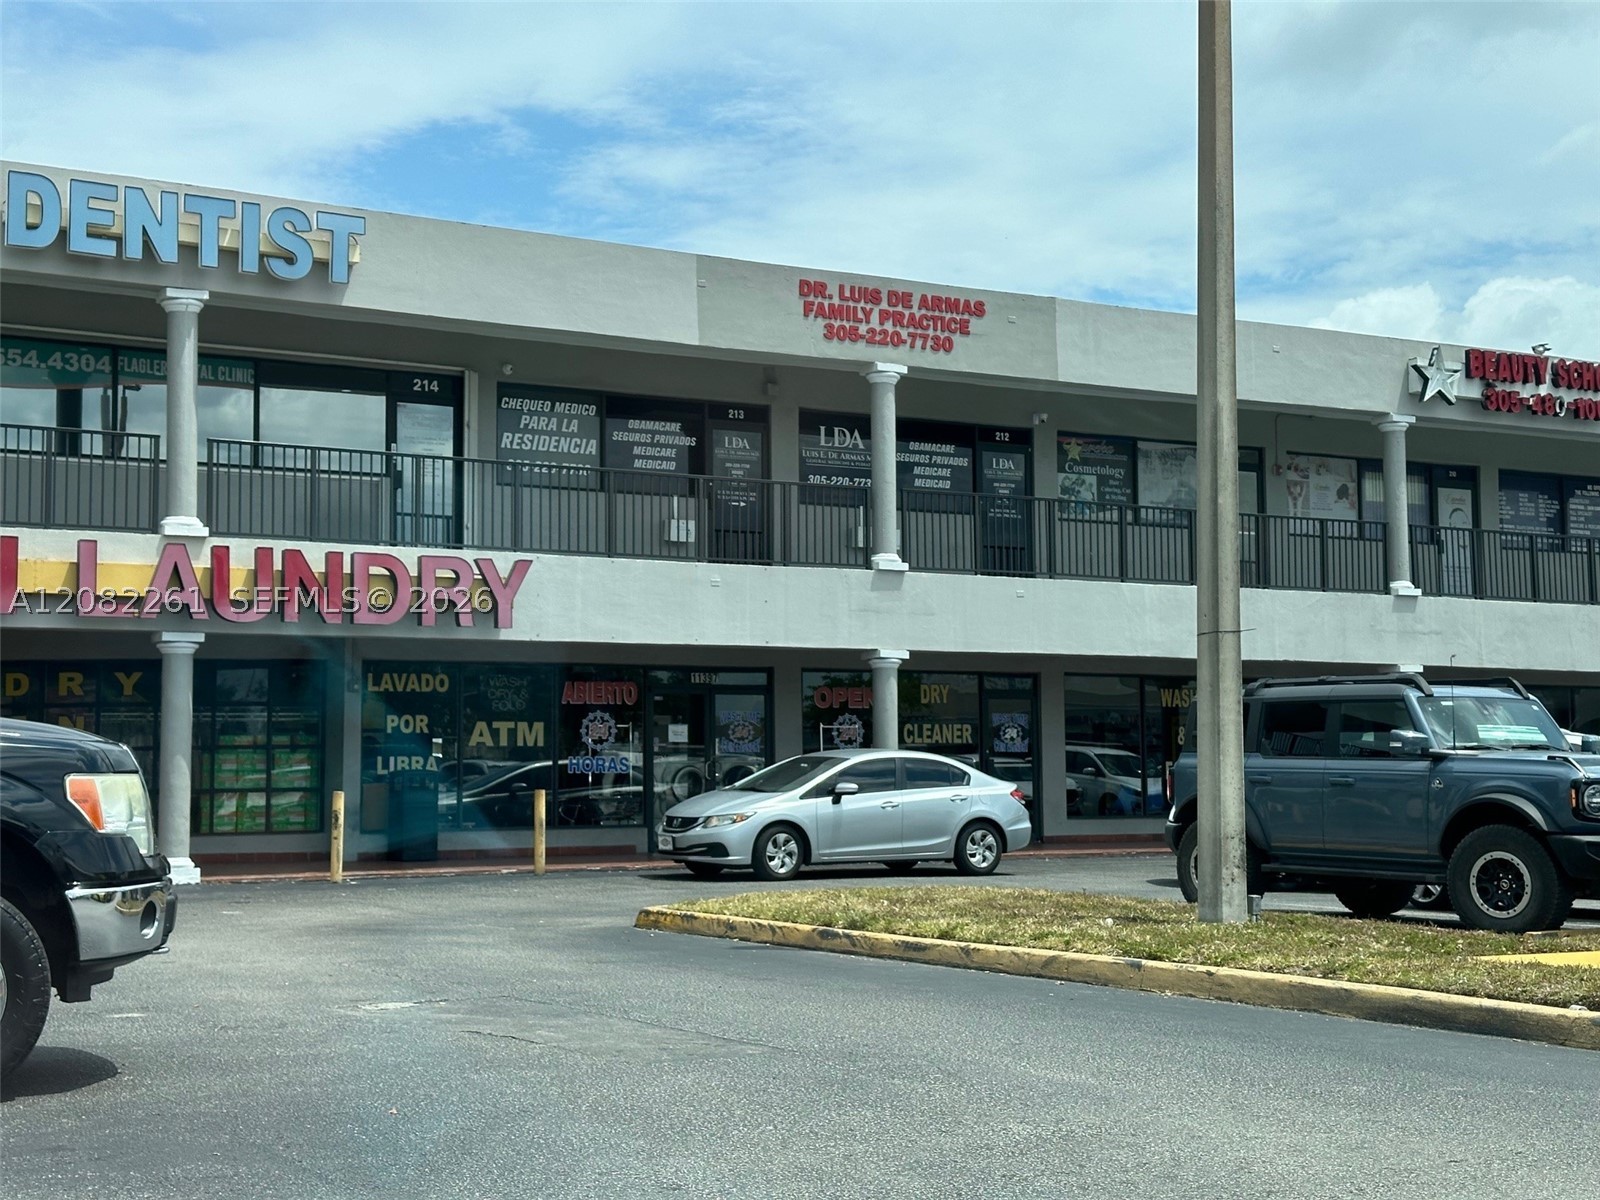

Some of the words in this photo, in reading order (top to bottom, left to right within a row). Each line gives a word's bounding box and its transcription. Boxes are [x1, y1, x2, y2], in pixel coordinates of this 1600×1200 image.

[4, 170, 366, 284] DENTIST
[799, 279, 833, 299] DR.
[839, 284, 882, 305] LUIS
[887, 290, 914, 308] DE
[918, 294, 986, 317] ARMAS
[803, 300, 874, 323] FAMILY
[878, 309, 971, 335] PRACTICE
[823, 323, 954, 352] 305-220-7730
[118, 355, 168, 376] FLAGLER
[218, 366, 255, 384] CLINIC
[1465, 348, 1548, 386] BEAUTY
[413, 379, 439, 392] 214
[501, 397, 551, 413] CHEQUEO
[554, 402, 597, 416] MEDICO
[728, 409, 745, 419] 213
[520, 415, 557, 431] PARA
[562, 418, 578, 433] LA
[628, 419, 682, 432] OBAMACARE
[501, 433, 597, 456] RESIDENCIA
[612, 431, 652, 443] SEGUROS
[654, 434, 697, 447] PRIVADOS
[725, 436, 750, 449] LDA
[819, 425, 866, 449] LDA
[995, 432, 1010, 441] 212
[633, 446, 677, 458] MEDICARE
[802, 449, 819, 458] LUIS
[840, 453, 865, 461] ARMAS
[909, 442, 955, 453] OBAMACARE
[633, 458, 676, 471] MEDICAID
[896, 452, 930, 464] SEGUROS
[931, 455, 968, 467] PRIVADOS
[992, 458, 1015, 470] LDA
[913, 466, 951, 477] MEDICARE
[1065, 462, 1126, 479] Cosmetology
[808, 474, 872, 487] 305-220-773
[914, 478, 950, 489] MEDICAID
[77, 539, 533, 629] LAUNDRY
[367, 673, 449, 693] LAVADO
[561, 681, 638, 705] ABIERTO
[920, 684, 949, 704] DRY
[386, 715, 429, 734] POR
[468, 721, 544, 746] ATM
[588, 722, 610, 741] 24
[904, 723, 972, 744] CLEANER
[568, 756, 630, 774] HORAS
